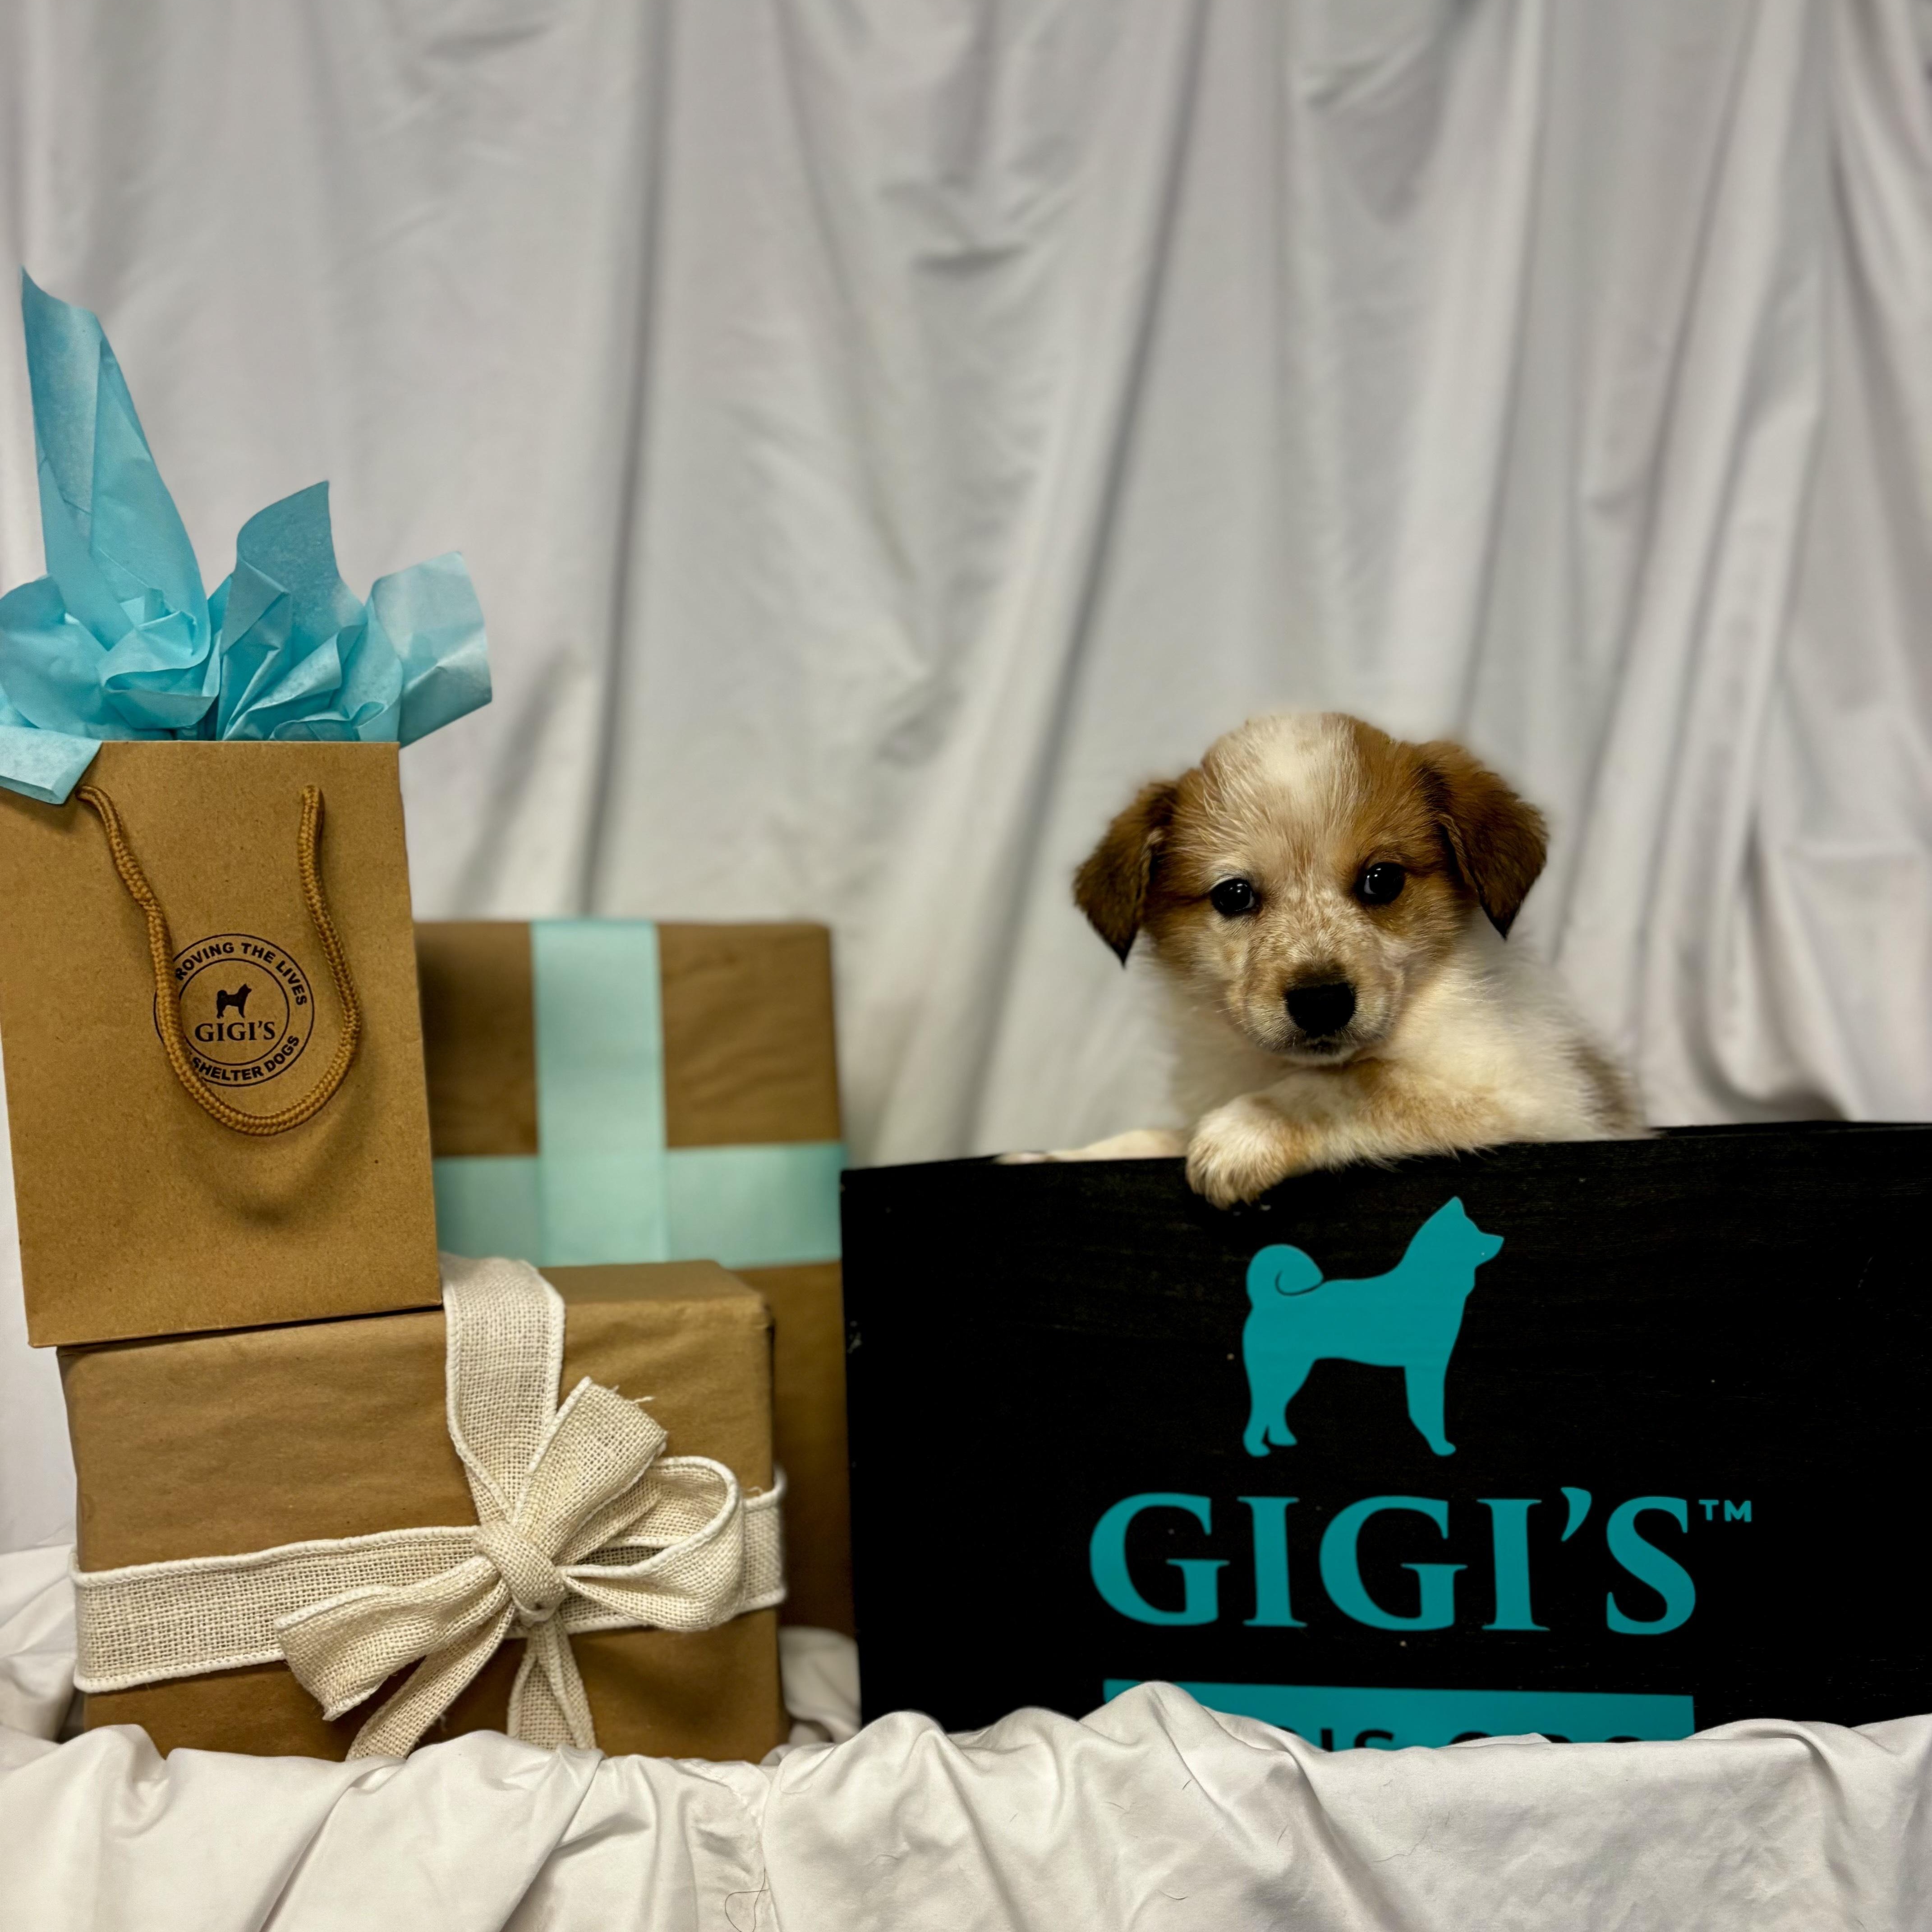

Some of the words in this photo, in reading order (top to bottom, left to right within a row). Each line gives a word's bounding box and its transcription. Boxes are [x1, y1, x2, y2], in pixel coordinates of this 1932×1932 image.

[175, 942, 234, 981] ROVING
[241, 942, 276, 964] THE
[276, 960, 307, 1006] LIVES
[193, 1057, 264, 1081] SHELTER
[263, 1035, 300, 1073] DOGS
[194, 1021, 276, 1042] GIGI'S
[1089, 1487, 1696, 1635] GIGI'S
